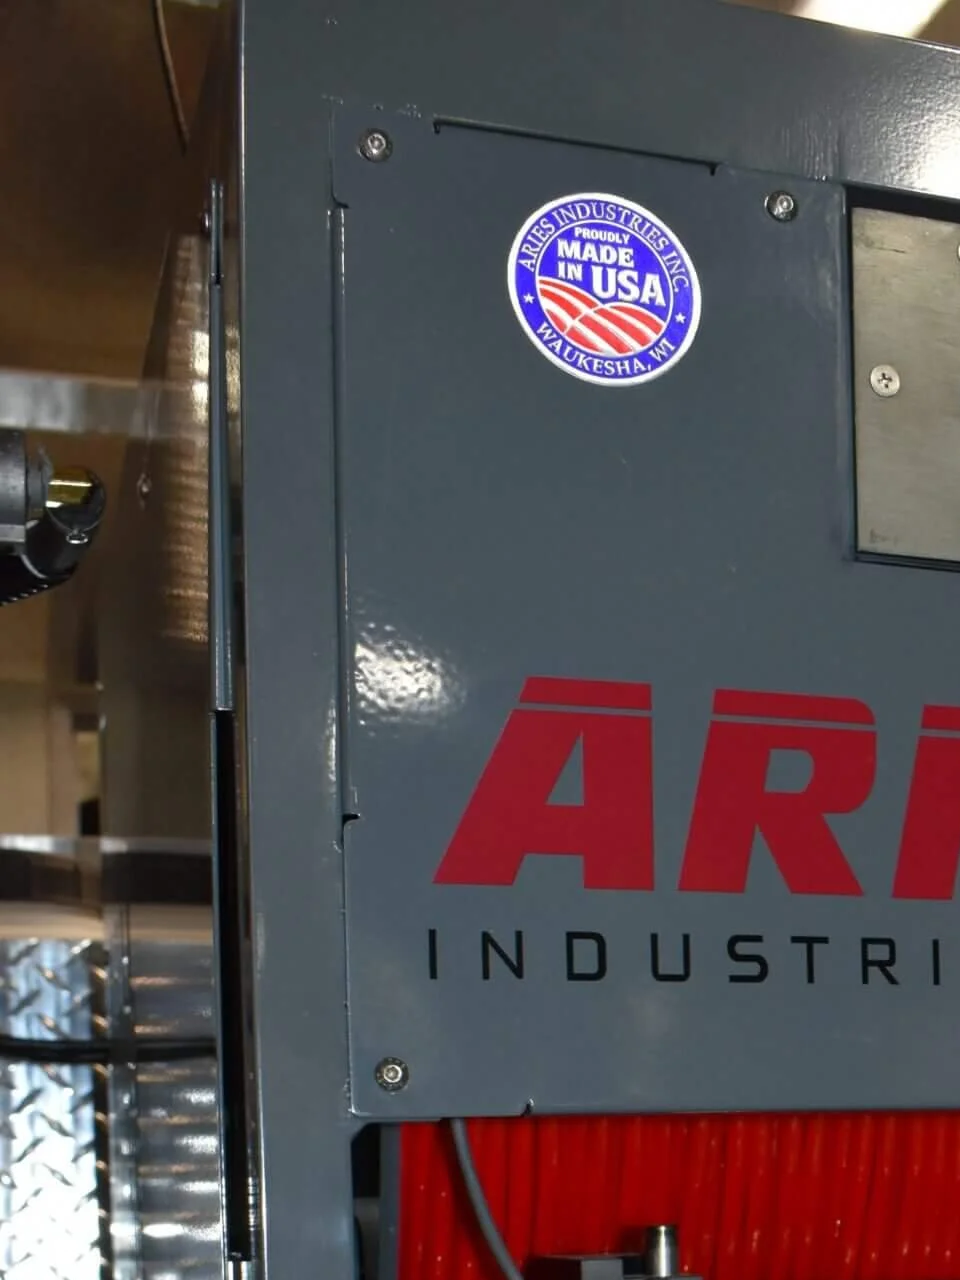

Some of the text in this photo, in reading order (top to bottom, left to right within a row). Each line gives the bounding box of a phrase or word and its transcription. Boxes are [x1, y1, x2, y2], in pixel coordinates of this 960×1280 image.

[518, 217, 556, 273] ARIES
[551, 201, 670, 251] INDUSTRIES
[574, 226, 631, 245] PROUDLY
[557, 238, 635, 268] MADE
[557, 261, 667, 307] IN USA
[648, 337, 677, 363] WI
